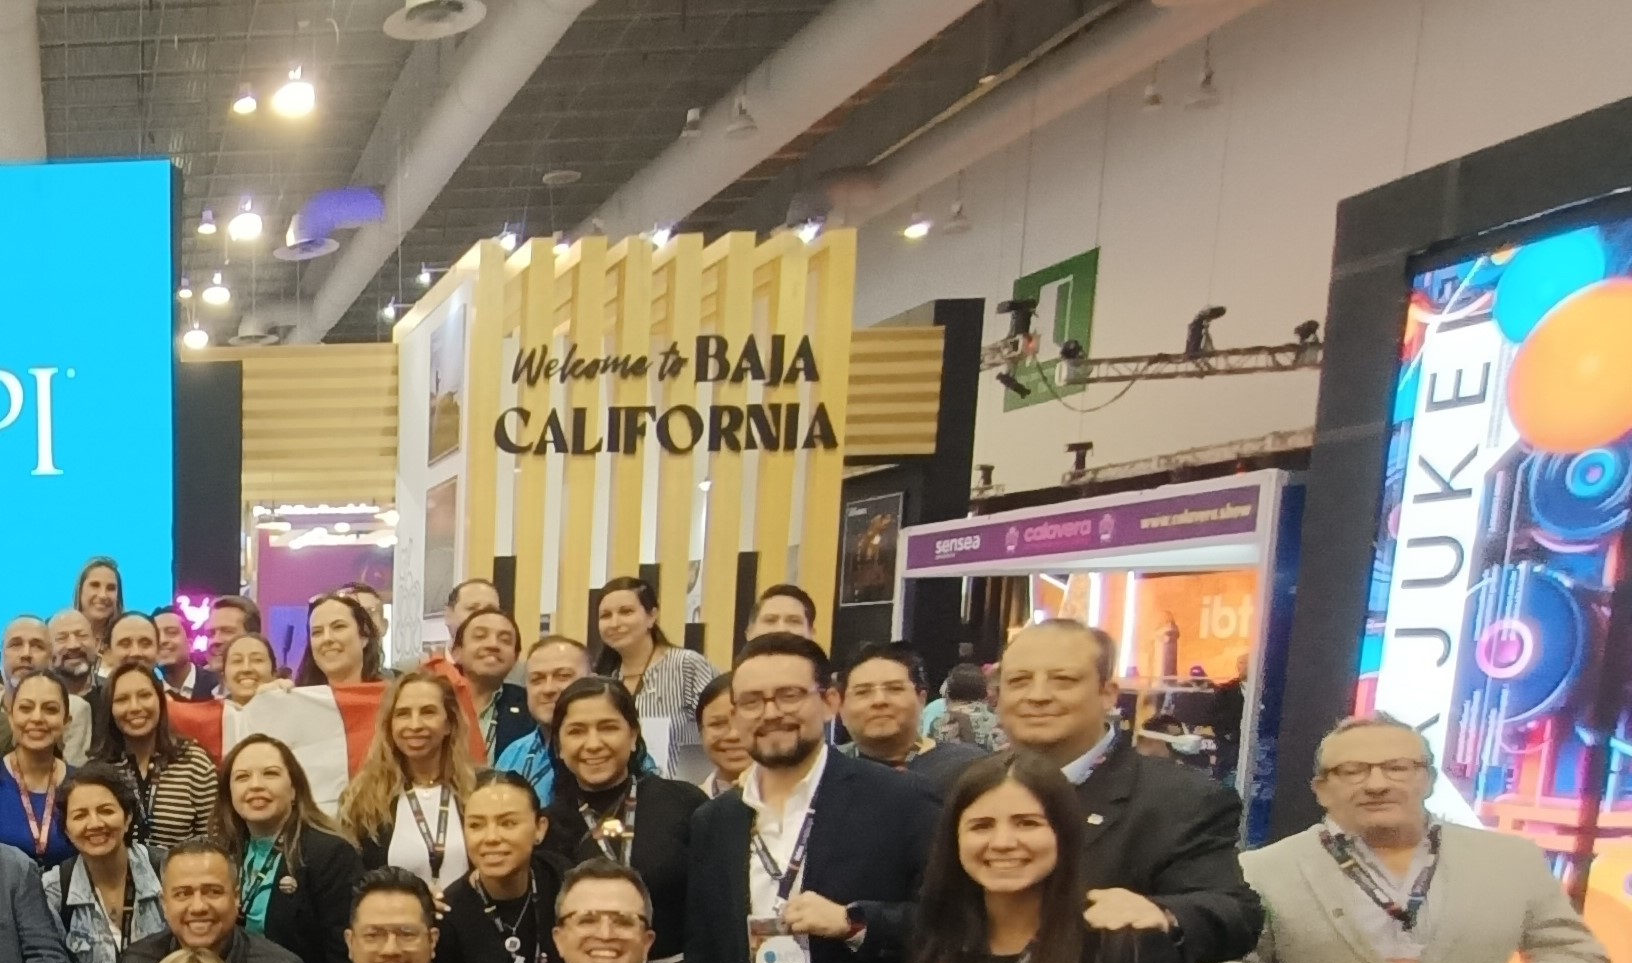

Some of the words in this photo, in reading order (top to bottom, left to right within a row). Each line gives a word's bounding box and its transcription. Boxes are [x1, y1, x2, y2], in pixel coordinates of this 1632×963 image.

[511, 343, 653, 386] Welcome
[657, 341, 689, 382] to
[694, 333, 820, 386] BAJA
[494, 401, 839, 455] CALIFORNIA
[935, 534, 981, 554] sensea
[1023, 519, 1092, 542] calavera
